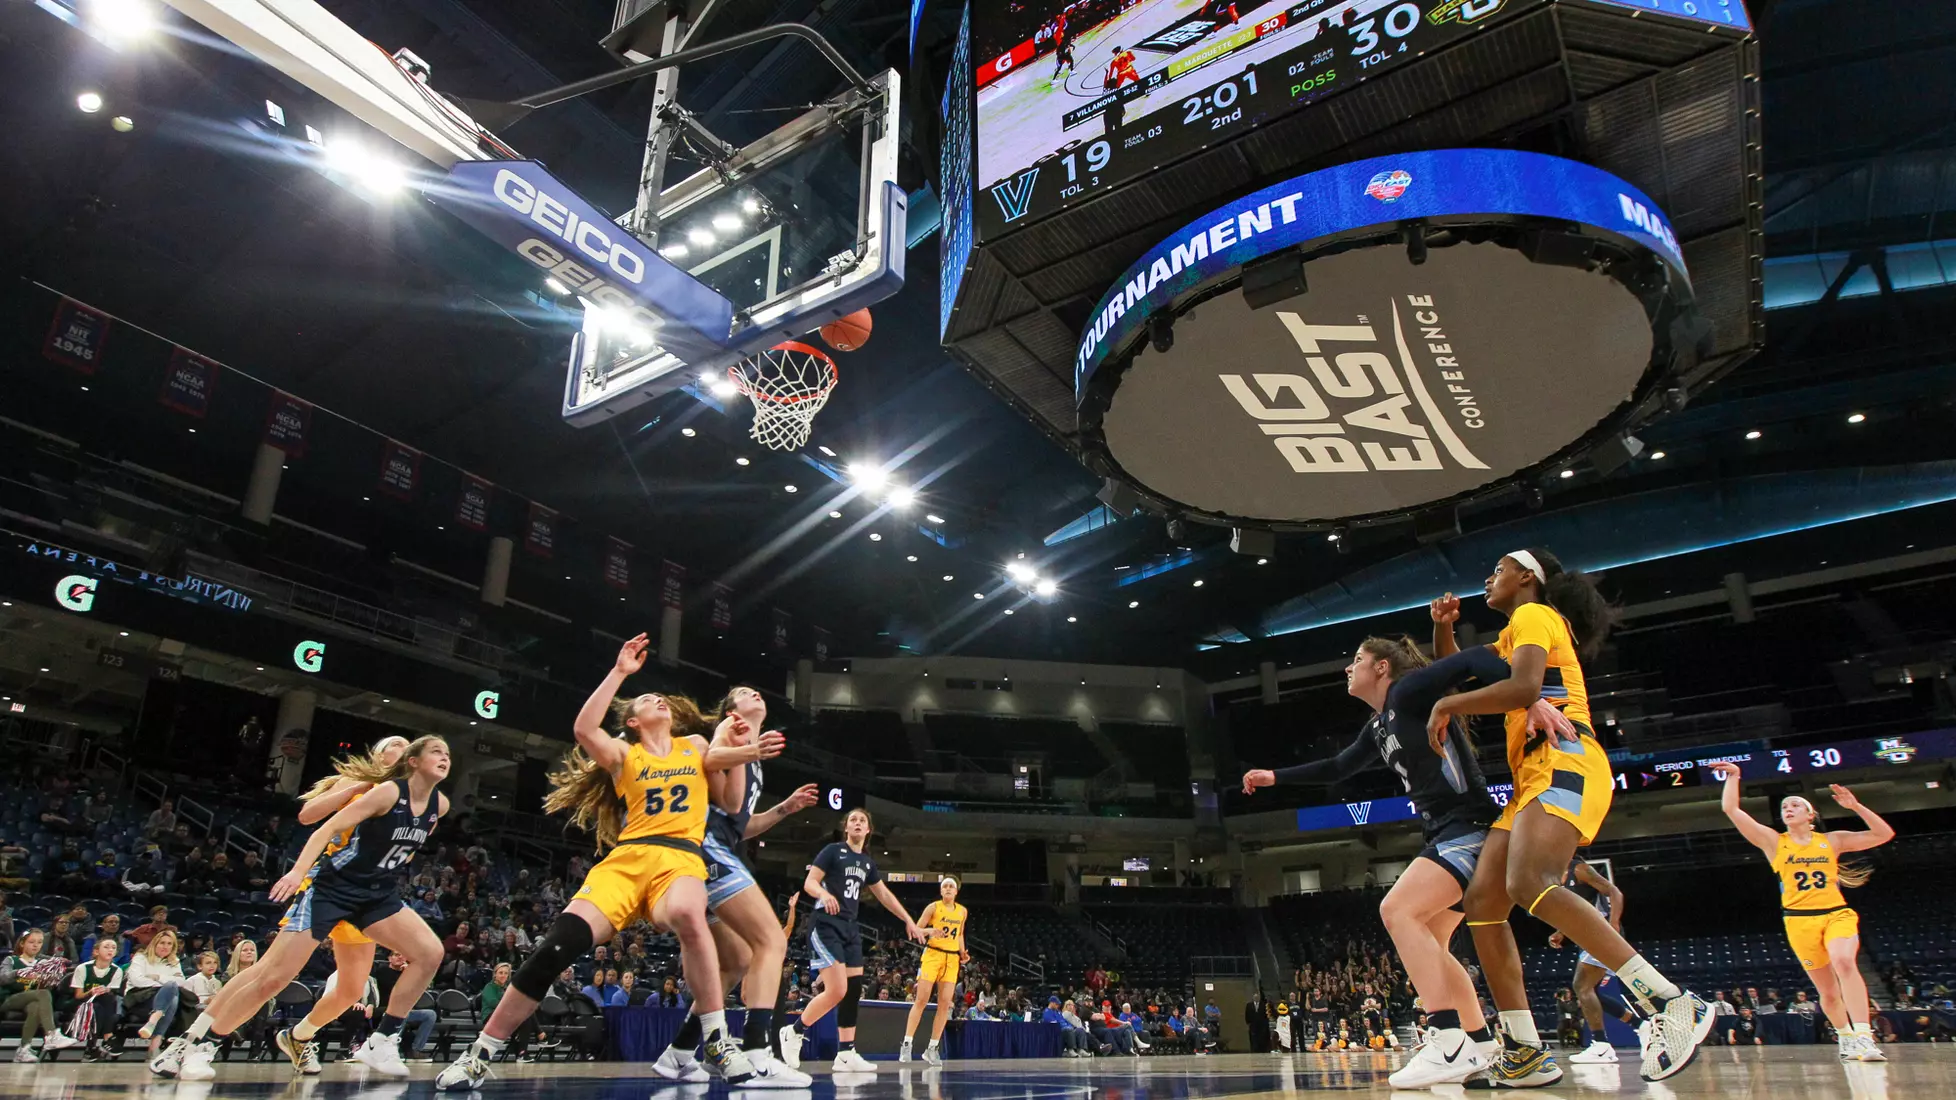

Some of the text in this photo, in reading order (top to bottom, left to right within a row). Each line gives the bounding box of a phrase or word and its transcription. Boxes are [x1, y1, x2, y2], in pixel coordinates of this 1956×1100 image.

[1261, 17, 1279, 33] 30
[1348, 3, 1420, 56] 30
[995, 51, 1012, 72] G
[1184, 40, 1233, 67] MARQUETTE
[1310, 52, 1335, 67] FOULS
[1312, 48, 1334, 59] TEAM
[1359, 42, 1408, 70] TOL 4
[1288, 61, 1305, 76] 02
[1290, 69, 1337, 97] POSS
[1076, 94, 1118, 118] VILLANOVA
[1147, 73, 1162, 87] 19
[1182, 71, 1258, 125] 2:01
[1211, 107, 1242, 130] 2nd
[1124, 133, 1142, 144] TEAM
[1124, 137, 1145, 149] FOULS
[1147, 125, 1163, 139] 03
[1061, 140, 1111, 182] 19
[1060, 176, 1099, 199] TOL 3
[494, 168, 645, 284] GEICO
[1079, 192, 1303, 373] TOURNAMENT
[69, 324, 91, 340] NIT
[53, 336, 94, 360] 1945
[1407, 294, 1485, 429] CONFERENCE
[175, 370, 205, 389] NCAA
[1275, 311, 1444, 471] EAST
[1218, 373, 1369, 473] BIG
[55, 574, 98, 612] G
[103, 653, 124, 667] 123
[294, 640, 326, 673] G
[158, 666, 178, 680] 124
[475, 690, 499, 719] G
[1655, 760, 1694, 773] PERIOD
[1776, 747, 1842, 774] 4 30
[636, 765, 698, 782] Marquette
[1670, 772, 1684, 787] 2
[644, 784, 690, 817] 52
[828, 788, 842, 810] G
[377, 844, 413, 870] 15
[1785, 853, 1830, 867] Marquette
[843, 878, 861, 900] 30
[1793, 870, 1827, 892] 23
[942, 926, 958, 940] 24
